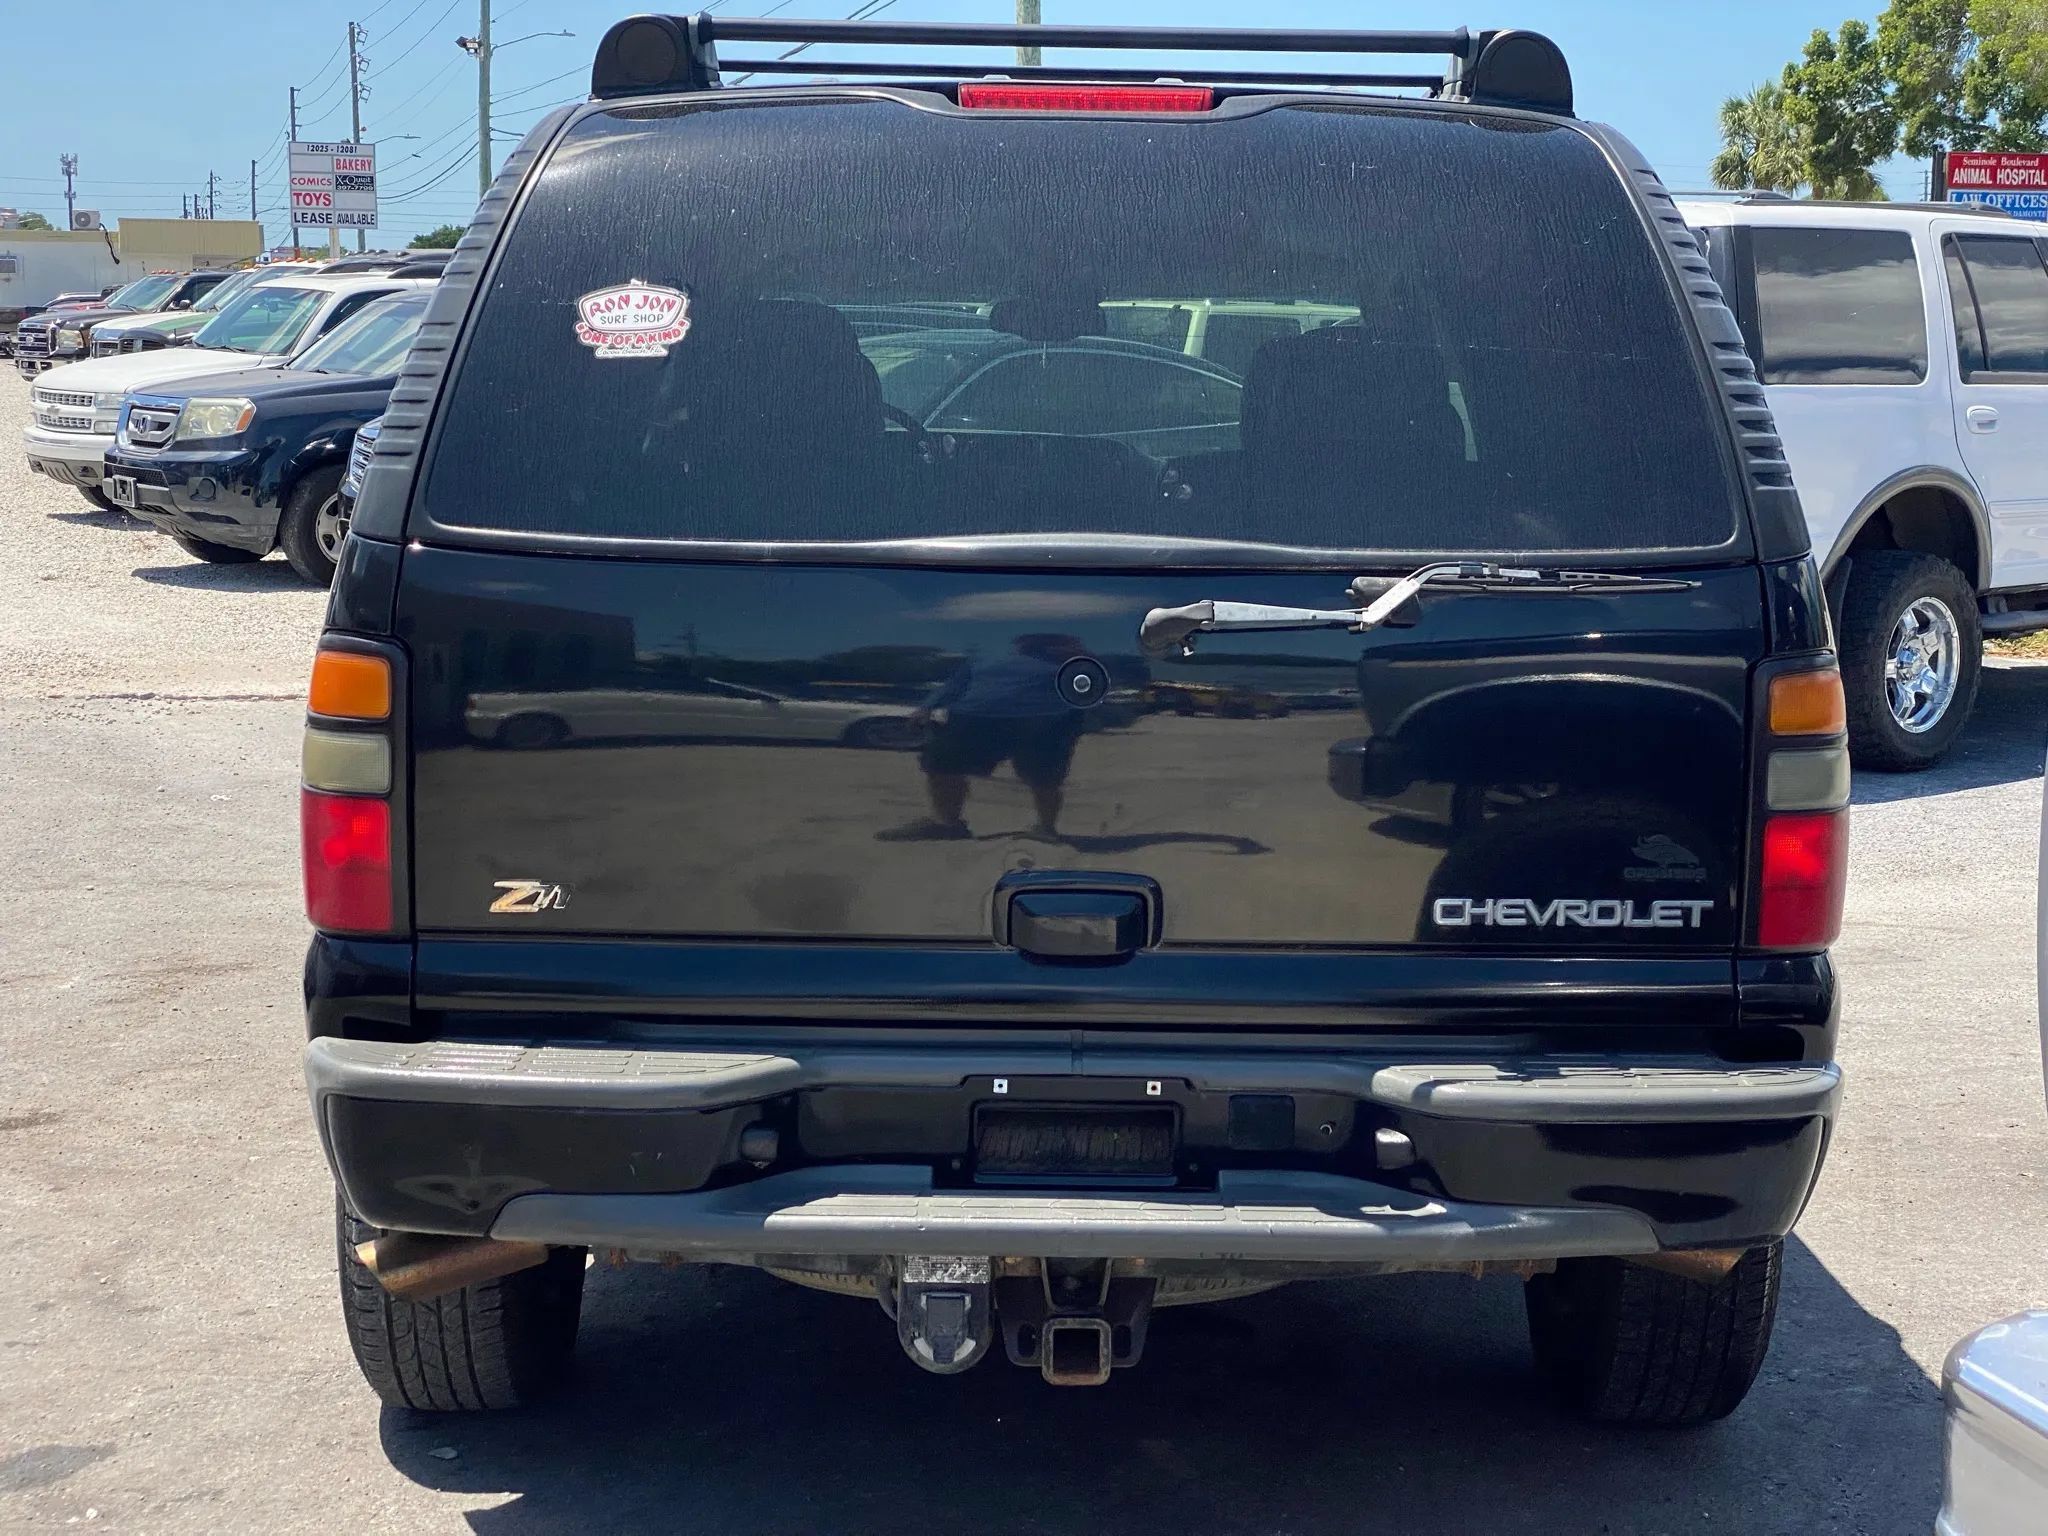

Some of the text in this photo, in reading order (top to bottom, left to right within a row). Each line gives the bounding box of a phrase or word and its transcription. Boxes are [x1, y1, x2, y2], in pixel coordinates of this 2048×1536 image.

[336, 145, 358, 154] 12081
[336, 159, 372, 171] BAKERY
[1962, 157, 2040, 167] Seminole Boulevard
[291, 178, 332, 186] COMICS
[1952, 168, 2048, 186] ANIMAL HOSPITAL
[293, 193, 332, 206] TOYS
[1986, 194, 2048, 208] OFFICES
[293, 212, 375, 225] LEASE AVAILABLE
[589, 294, 677, 318] RON JON
[600, 313, 664, 325] SURF SHOP
[613, 334, 633, 345] OF
[635, 334, 645, 345] A
[1433, 897, 1714, 928] CHEVROLET
